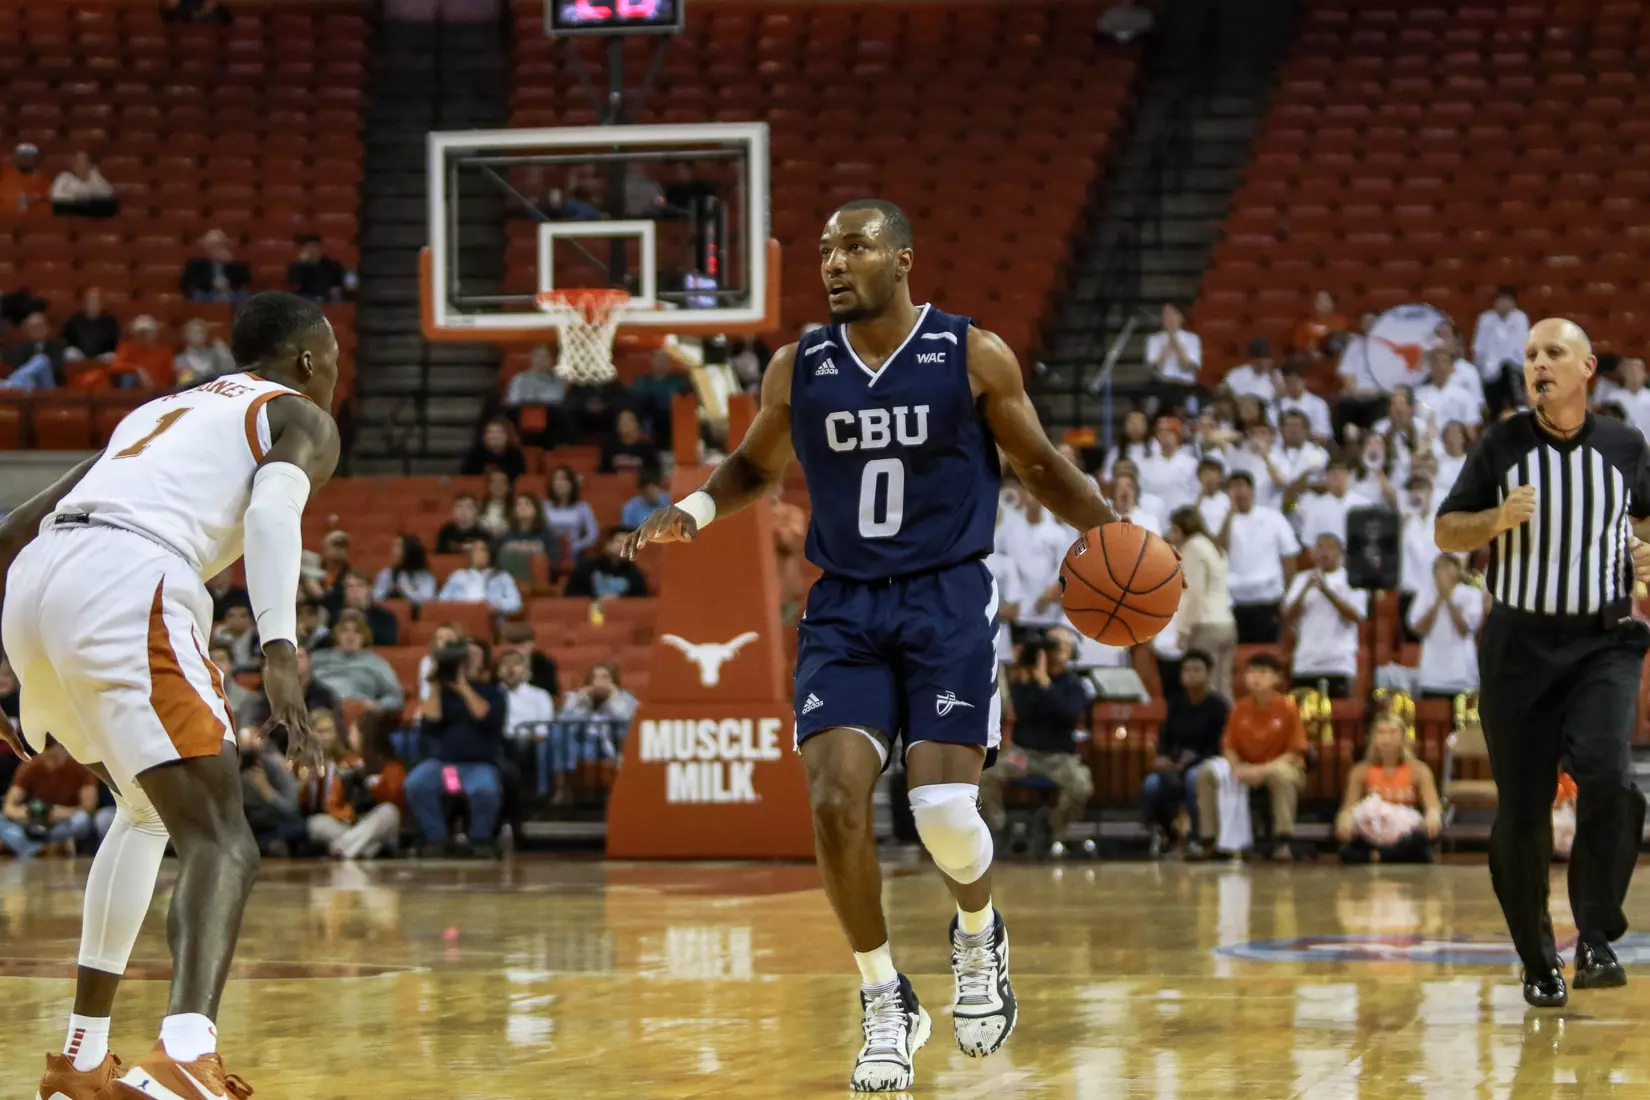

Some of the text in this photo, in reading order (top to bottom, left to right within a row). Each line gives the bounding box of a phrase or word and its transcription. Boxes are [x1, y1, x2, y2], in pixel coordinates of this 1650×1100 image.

[916, 352, 946, 364] WAC
[112, 407, 194, 460] 1
[825, 404, 930, 452] CBU
[859, 457, 905, 538] 0
[802, 700, 824, 715] adidas
[639, 717, 782, 761] MUSCLE
[666, 761, 757, 804] MILK
